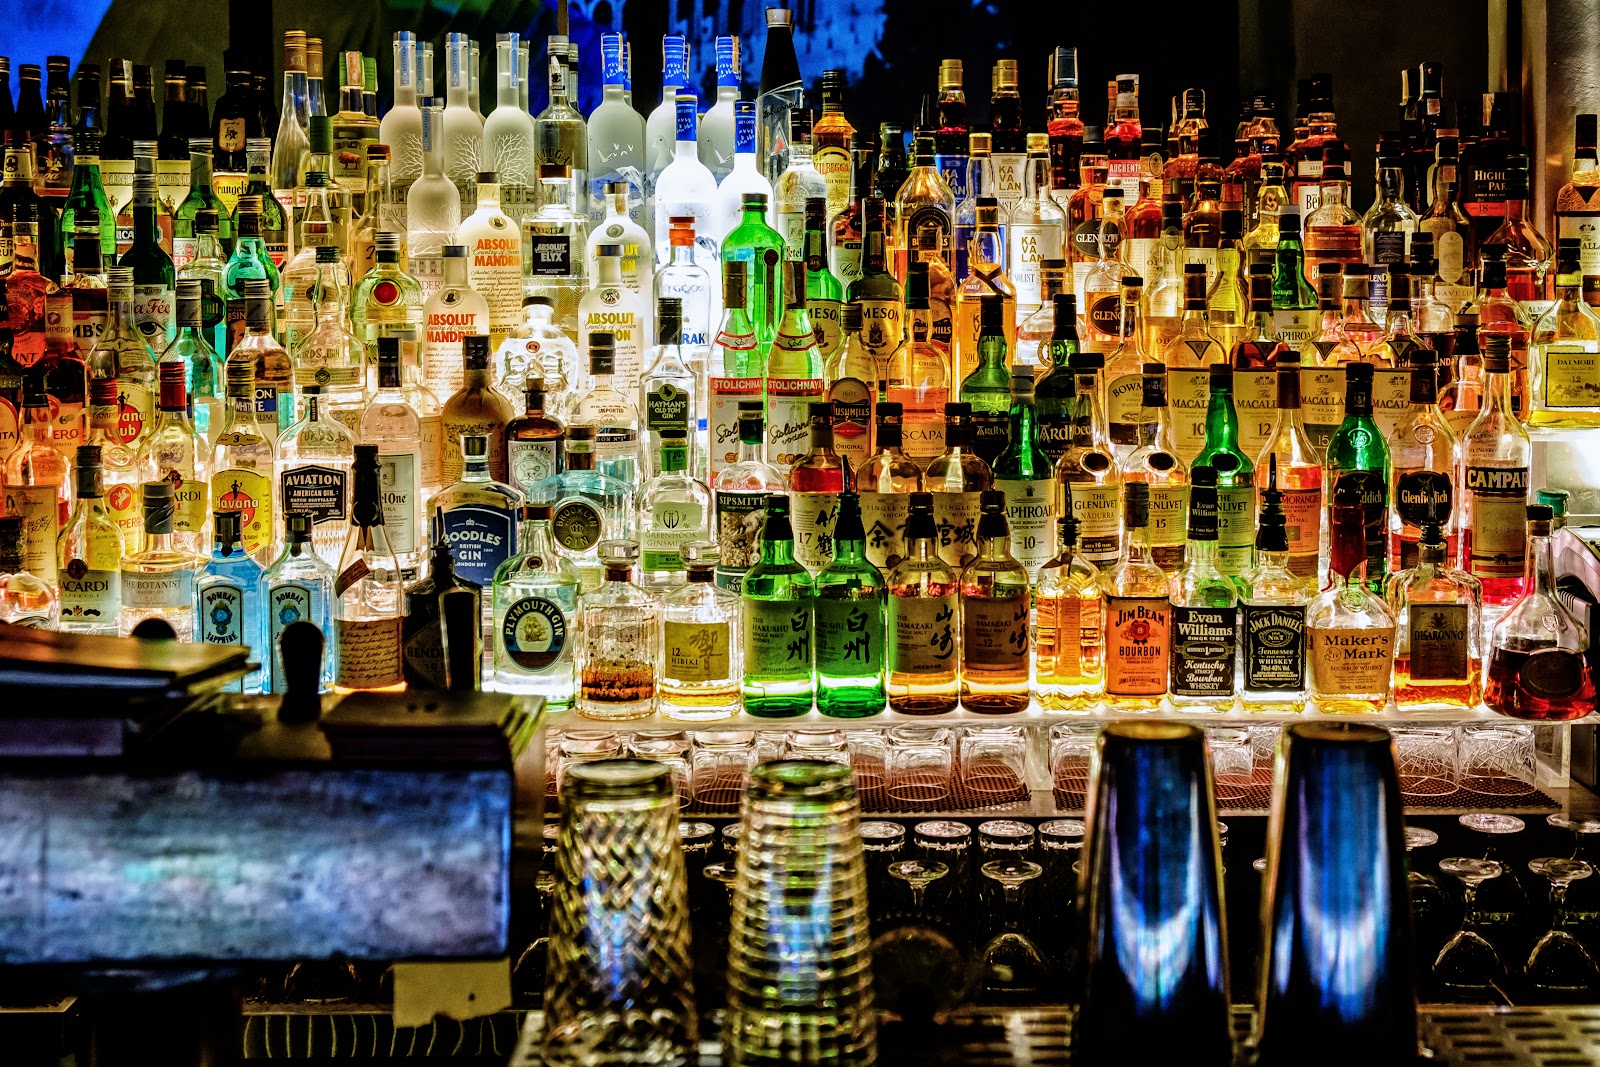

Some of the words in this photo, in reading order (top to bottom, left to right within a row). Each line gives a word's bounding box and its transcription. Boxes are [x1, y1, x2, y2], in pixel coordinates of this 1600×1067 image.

[999, 165, 1013, 175] KA
[1109, 163, 1141, 172] AUCHENT
[999, 174, 1014, 183] VA
[999, 182, 1022, 191] LAN
[1479, 204, 1488, 212] 18
[476, 239, 519, 251] ABSOLUT
[1021, 237, 1037, 246] KA
[534, 243, 567, 253] ABSOLUT
[1021, 245, 1036, 254] VA
[474, 255, 520, 267] MANDRIN
[541, 252, 562, 263] ELYX
[1021, 254, 1044, 263] LAN
[1188, 256, 1214, 265] CAOL
[428, 313, 477, 325] ABSOLUT
[588, 312, 635, 325] ABSOLUT
[425, 331, 477, 343] MANDRIN
[713, 380, 762, 390] STOLICHNA
[1112, 383, 1142, 398] BOWM
[1257, 390, 1271, 399] The
[1317, 388, 1330, 396] The
[649, 400, 686, 409] HAYMAN'S
[1237, 399, 1278, 408] MACALL
[1301, 395, 1345, 405] MACALLA
[835, 407, 870, 417] USHMILLS
[901, 428, 943, 440] SCAPA
[1192, 423, 1206, 435] 10
[1258, 423, 1271, 435] 12
[1318, 434, 1329, 446] 15
[286, 475, 341, 486] AVIATION
[1467, 468, 1528, 488] CAMPAR
[293, 489, 321, 497] AMERICAN
[1074, 499, 1118, 510] GLENLIVET
[1149, 499, 1184, 510] ENLIVET
[1217, 501, 1248, 512] NLIVET
[556, 505, 598, 527] BROOKLYN
[1005, 504, 1054, 517] APHROAIG
[1155, 519, 1167, 528] 15
[1218, 518, 1229, 528] 12
[443, 530, 502, 546] BOODLES
[564, 536, 589, 549] GIN
[798, 532, 812, 544] 17
[1023, 535, 1036, 549] 10
[458, 551, 482, 561] GIN
[61, 579, 109, 592] ACARDI
[137, 579, 182, 590] BOTANIST
[726, 583, 742, 591] DRY
[206, 591, 236, 604] BOMBAY
[276, 591, 304, 604] BOMBAY
[505, 600, 555, 636] PLYMOUTH
[551, 614, 565, 637] GIN
[1115, 609, 1136, 628] JIM
[1137, 605, 1165, 625] BEAM
[1188, 611, 1223, 623] Evan
[752, 624, 789, 632] HAKUSHU
[976, 620, 1012, 628] YAMAZAKI
[1177, 622, 1233, 636] Williams
[1249, 618, 1272, 633] JACK
[205, 631, 238, 643] SAPPHIRE
[1324, 635, 1389, 646] Maker's
[1414, 630, 1464, 641] DISARONNO
[983, 638, 993, 648] 12
[671, 647, 681, 656] 12
[1119, 646, 1161, 656] BOURBON
[1257, 646, 1294, 655] Tennessee
[1343, 648, 1388, 659] Mark
[671, 657, 699, 665] HIBIKI
[1183, 660, 1226, 671] Kentucky
[1185, 674, 1224, 684] Bourbon
